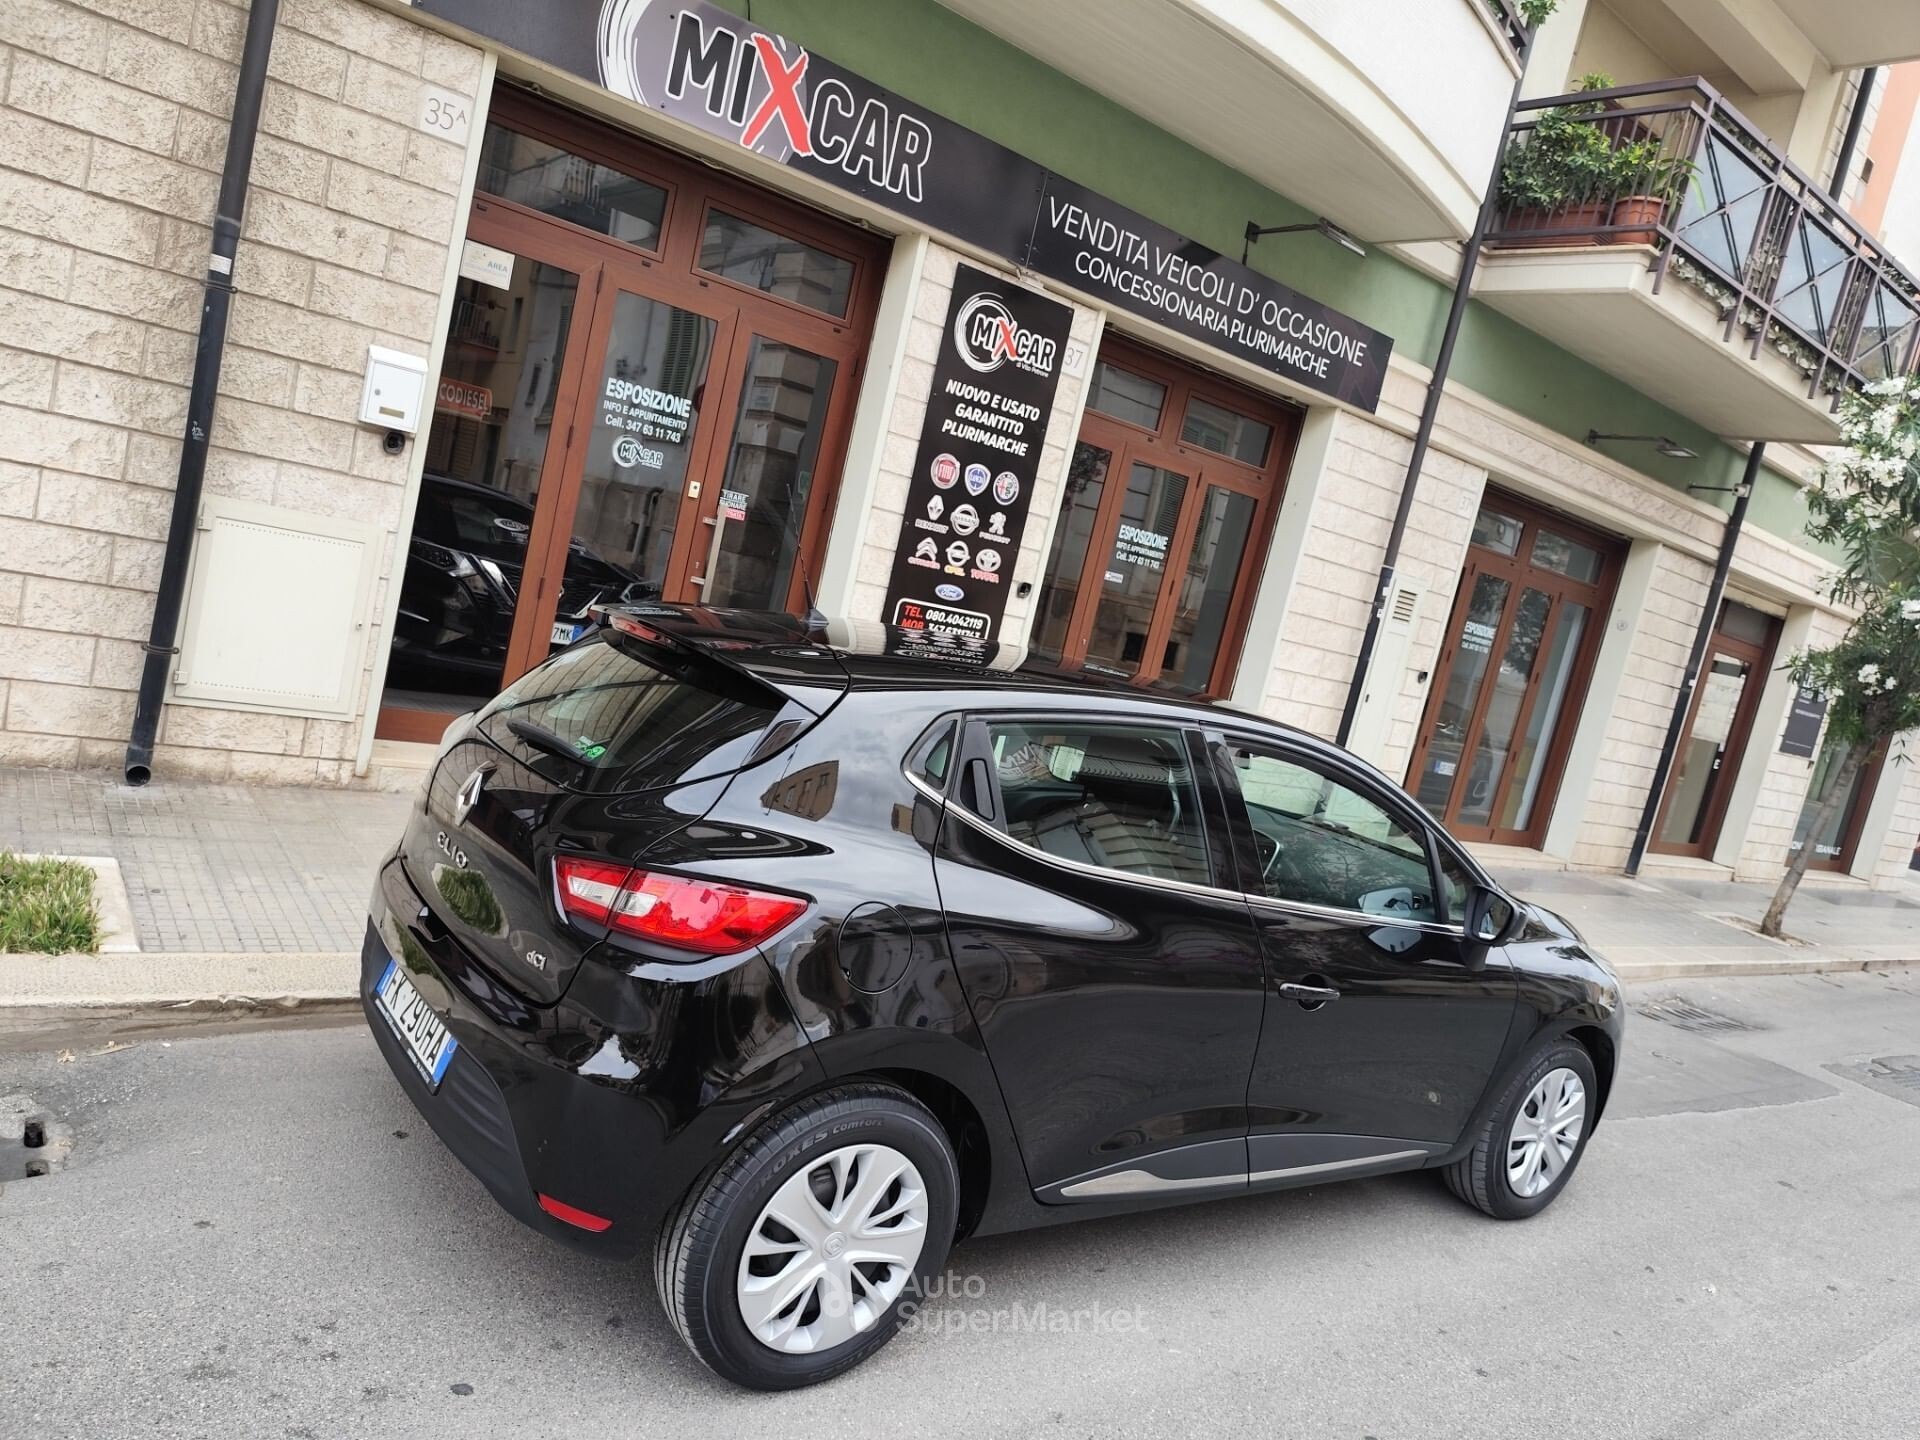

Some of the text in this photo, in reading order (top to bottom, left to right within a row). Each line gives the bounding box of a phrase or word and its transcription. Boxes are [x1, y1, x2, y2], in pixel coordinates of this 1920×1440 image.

[665, 9, 932, 203] MIXCAR
[1050, 196, 1149, 270] VENDITA
[1155, 246, 1235, 308] VEICOLI
[1261, 299, 1368, 368] OCCASIONE
[1075, 251, 1330, 380] CONCESSIONARIA PLURIMARCHE
[970, 312, 1058, 373] MIXCAR
[1064, 346, 1085, 370] 37
[603, 399, 688, 431] INFO E APPUNTAMENTO
[605, 377, 692, 418] ESPOSIZIONE
[945, 379, 1041, 422] NUOVO E USATO
[605, 414, 681, 444] Cell. 347 63 11 743
[941, 418, 1029, 457] PLURIMARCHE
[955, 403, 1024, 436] GARANTITO
[620, 442, 664, 466] MIXCAR
[1118, 524, 1169, 550] ESPOSIZIONE
[905, 605, 984, 630] TEL. 080.4042119
[437, 831, 468, 869] CLIO
